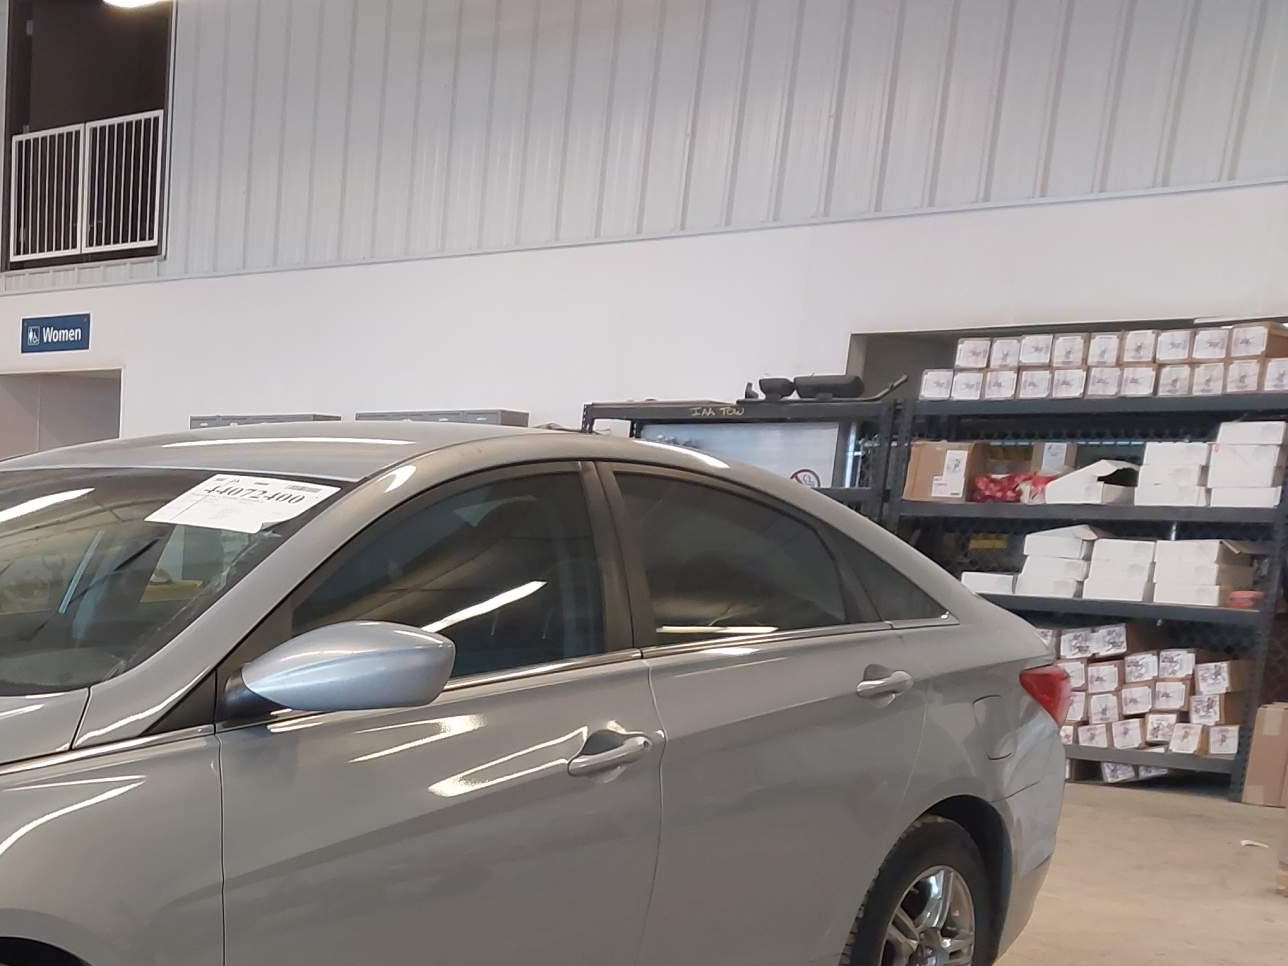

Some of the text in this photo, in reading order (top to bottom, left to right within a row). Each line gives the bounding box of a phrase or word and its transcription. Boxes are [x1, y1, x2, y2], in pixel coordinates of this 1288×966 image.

[42, 327, 82, 343] Women
[719, 406, 745, 417] TOW
[203, 484, 306, 505] 44072400
